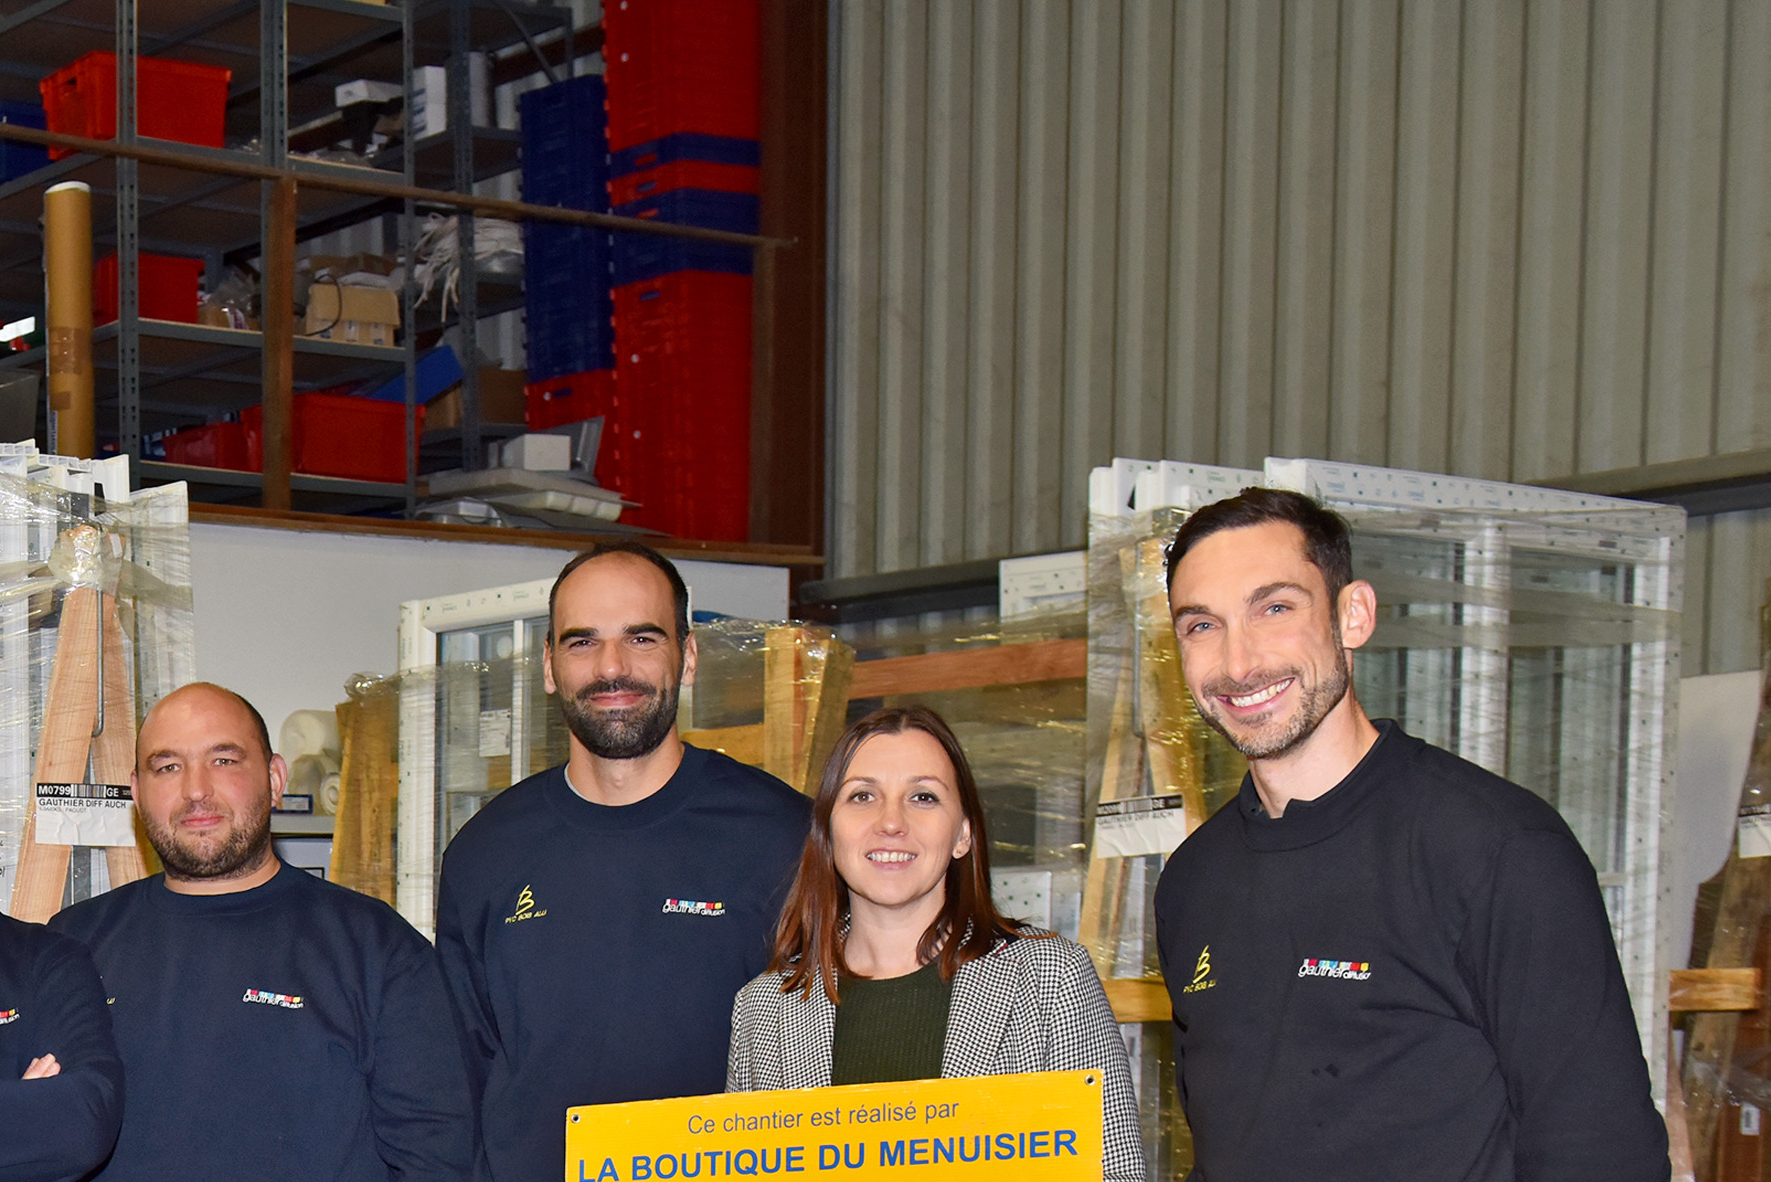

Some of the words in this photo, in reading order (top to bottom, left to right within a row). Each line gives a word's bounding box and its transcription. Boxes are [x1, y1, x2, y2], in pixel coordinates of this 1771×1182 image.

[38, 785, 71, 796] M0799
[106, 787, 119, 797] GE
[39, 798, 84, 807] GAUTHIER
[86, 800, 103, 808] DIFF
[105, 801, 127, 809] AUCH
[688, 1115, 715, 1134] Ce
[723, 1110, 804, 1132] chantier
[811, 1107, 841, 1126] est
[849, 1100, 917, 1124] réalisé
[925, 1102, 960, 1124] par
[632, 1146, 805, 1181] BOUTIQUE
[818, 1142, 865, 1171] DU
[879, 1129, 1078, 1167] MENUISIER
